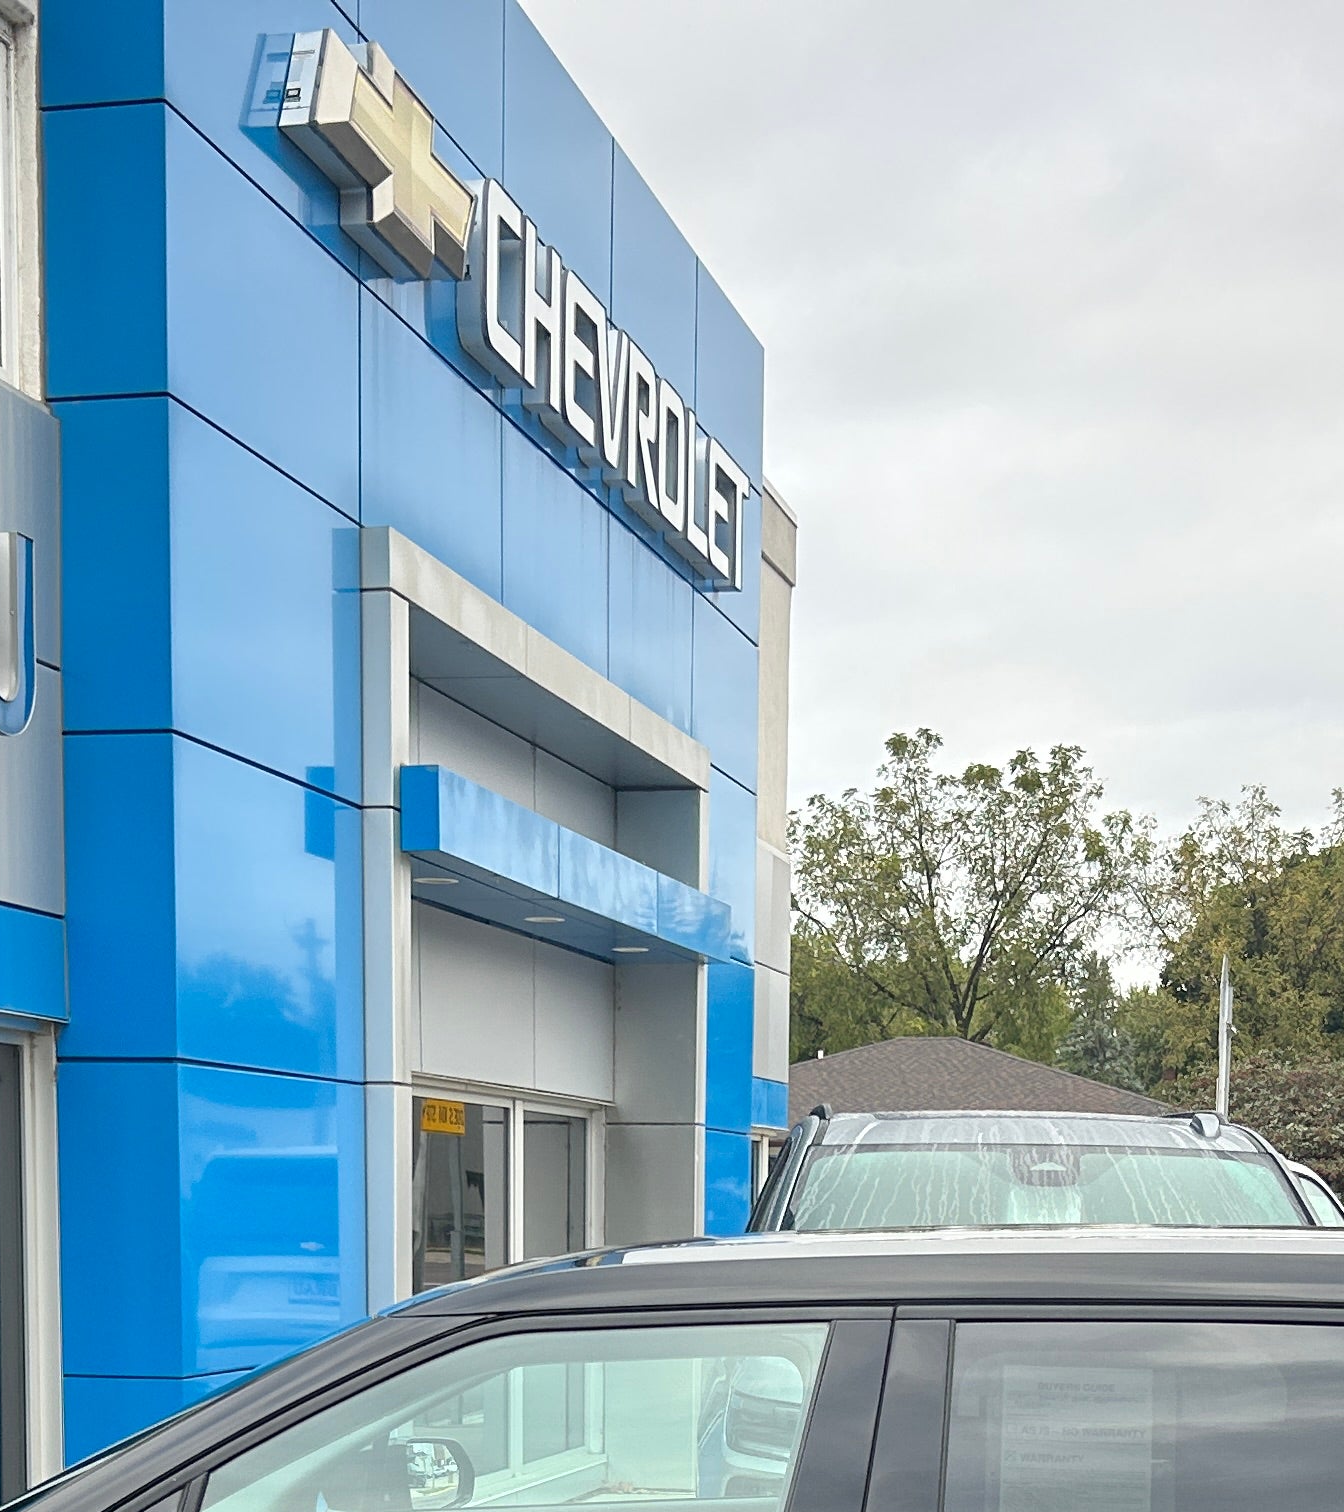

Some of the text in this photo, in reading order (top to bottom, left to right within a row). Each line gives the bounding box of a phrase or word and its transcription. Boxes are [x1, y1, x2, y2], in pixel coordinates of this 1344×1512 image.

[474, 177, 751, 592] CHEVROLET
[1083, 1383, 1116, 1393] GUIDE
[1082, 1427, 1146, 1440] WARRANTY
[1021, 1452, 1085, 1464] WARRANTY
